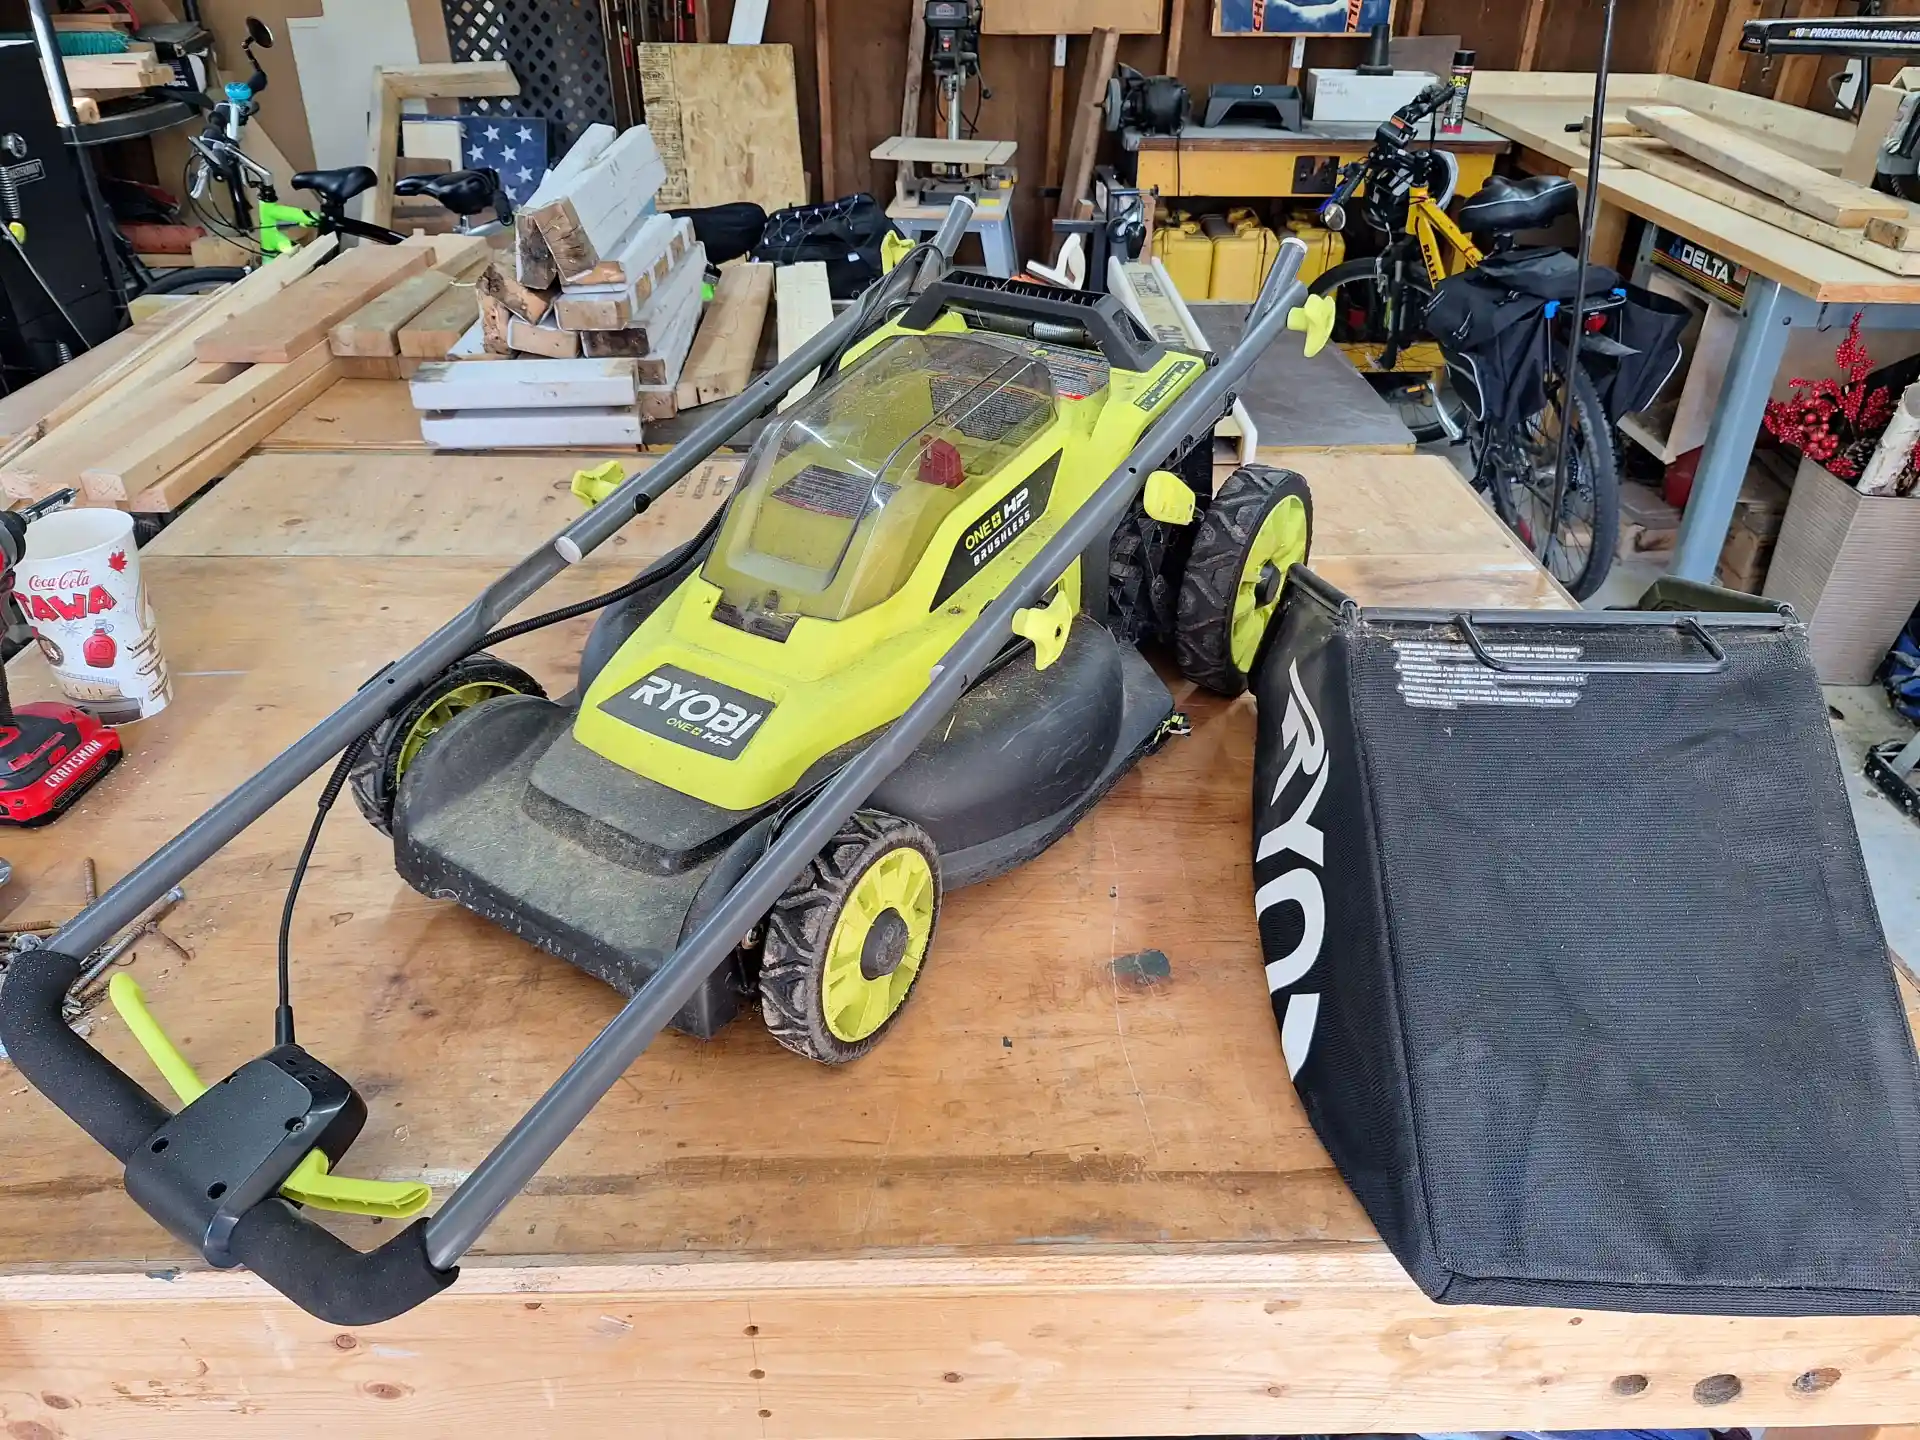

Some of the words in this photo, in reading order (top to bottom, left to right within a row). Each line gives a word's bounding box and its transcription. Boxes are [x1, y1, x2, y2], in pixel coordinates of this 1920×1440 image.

[1810, 28, 1869, 40] PROFESSIONAL
[1870, 30, 1901, 41] RADIAL
[1680, 244, 1728, 285] DELTA
[1003, 487, 1029, 519] HP
[973, 510, 1031, 567] BRUSHLESS
[29, 568, 91, 591] Coca-Cola
[628, 675, 763, 740] RYOBI
[701, 731, 732, 747] HP
[45, 739, 103, 788] CRAFTSMAN
